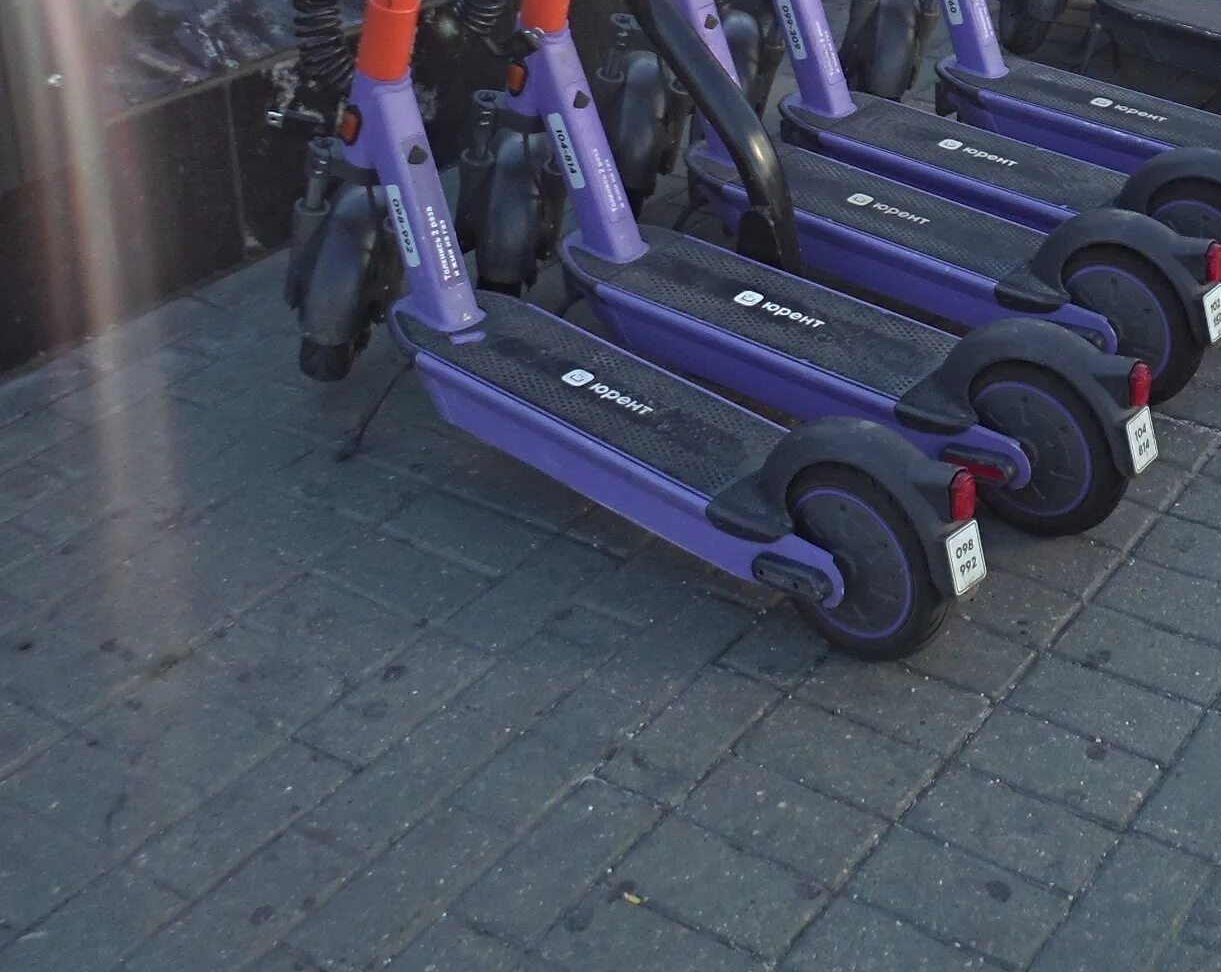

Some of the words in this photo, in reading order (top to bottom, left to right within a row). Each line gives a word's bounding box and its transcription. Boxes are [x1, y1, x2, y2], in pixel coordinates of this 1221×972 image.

[1114, 104, 1168, 122] юрент
[556, 129, 577, 174] 104-814
[961, 146, 1019, 168] юрент
[872, 202, 931, 226] юрент
[391, 198, 414, 254] 098-992
[430, 228, 440, 237] 2
[761, 301, 826, 328] юрент
[589, 382, 654, 415] юрент
[1134, 422, 1147, 441] 104
[1138, 438, 1150, 456] 814
[955, 538, 975, 559] 098
[959, 556, 978, 577] 992
